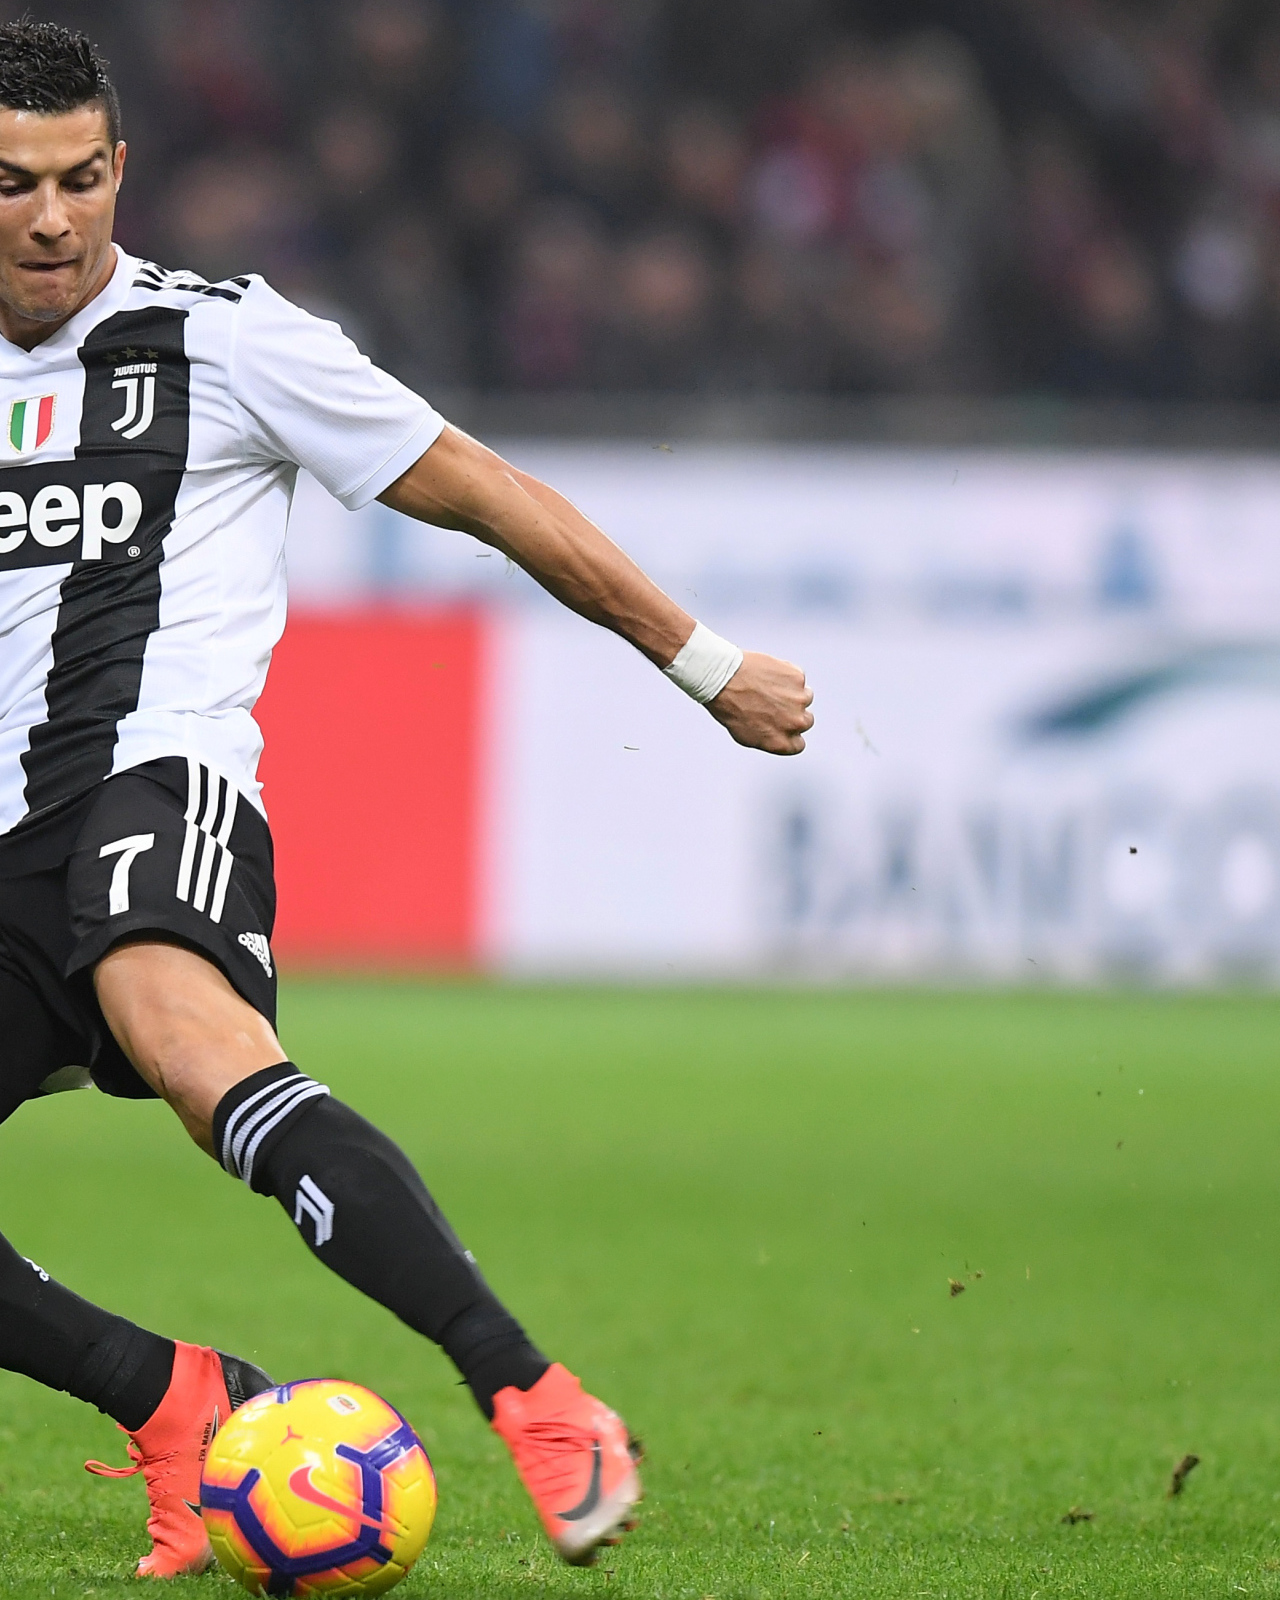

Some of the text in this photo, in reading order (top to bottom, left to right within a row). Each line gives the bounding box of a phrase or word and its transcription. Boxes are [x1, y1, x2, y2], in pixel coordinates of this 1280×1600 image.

[113, 363, 157, 377] JUVENTUS
[99, 832, 155, 916] 7
[201, 1422, 212, 1446] MARIA
